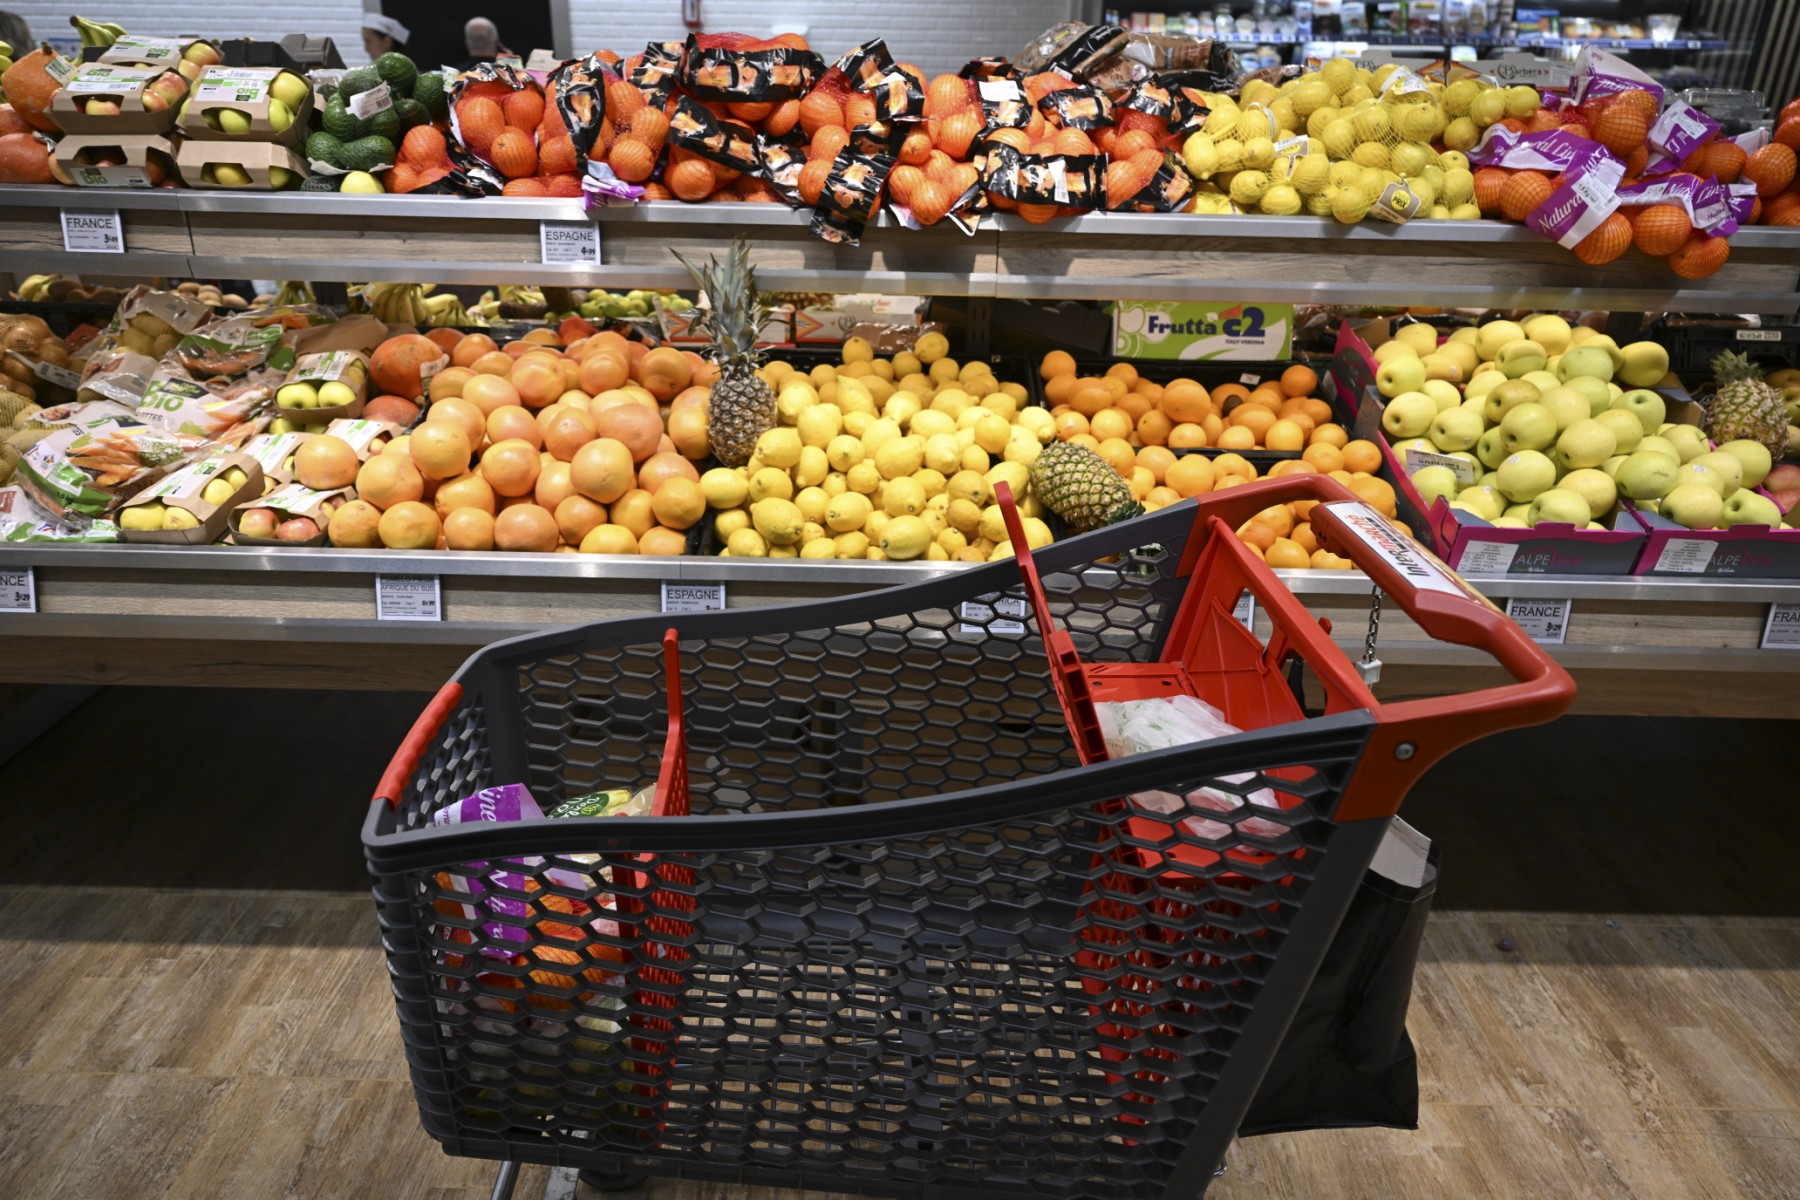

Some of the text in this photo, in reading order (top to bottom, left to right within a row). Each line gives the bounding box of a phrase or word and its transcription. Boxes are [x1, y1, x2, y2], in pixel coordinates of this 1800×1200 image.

[1538, 193, 1584, 233] Natura
[66, 217, 113, 228] FRANCE
[546, 231, 594, 241] ESPAGNE
[1148, 315, 1217, 335] Frutta
[667, 590, 719, 599] ESPAGNE
[1510, 606, 1561, 617] FRANCE
